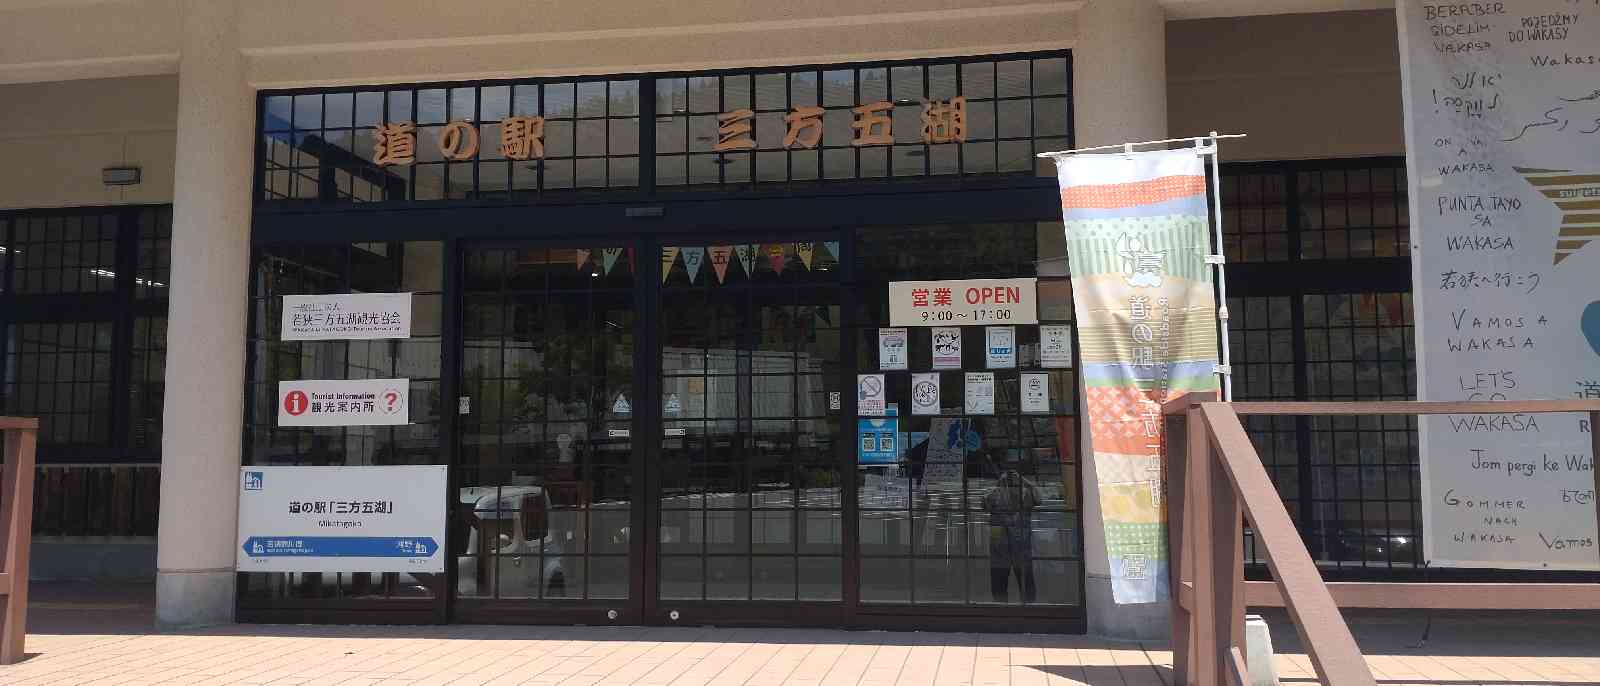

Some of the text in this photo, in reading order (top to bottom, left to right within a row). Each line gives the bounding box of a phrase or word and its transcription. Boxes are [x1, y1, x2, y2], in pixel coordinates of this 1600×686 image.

[1423, 3, 1505, 20] BERABER
[1508, 27, 1569, 42] DO WAKASY
[1530, 53, 1600, 67] Wakas
[372, 94, 968, 168] 道の駅 三方五湖
[1438, 162, 1495, 177] WAKASA
[1438, 194, 1522, 215] PUNTA TAYO
[1472, 214, 1493, 227] SA
[1446, 235, 1514, 251] WAKASA
[911, 286, 1021, 307] 営業 OPEN
[1451, 308, 1549, 331] VAMOS A
[1447, 336, 1536, 353] WAKASA
[1459, 369, 1518, 391] LET'S
[312, 392, 375, 400] Tourist Information
[312, 401, 374, 413] 観光案内所
[1448, 413, 1541, 432] WAKASA
[1470, 448, 1501, 470] Jom
[1507, 456, 1537, 477] pergi
[1543, 453, 1560, 472] ke
[289, 501, 393, 514] 道の駅「三方五湖」
[1453, 532, 1518, 545] WAKASA
